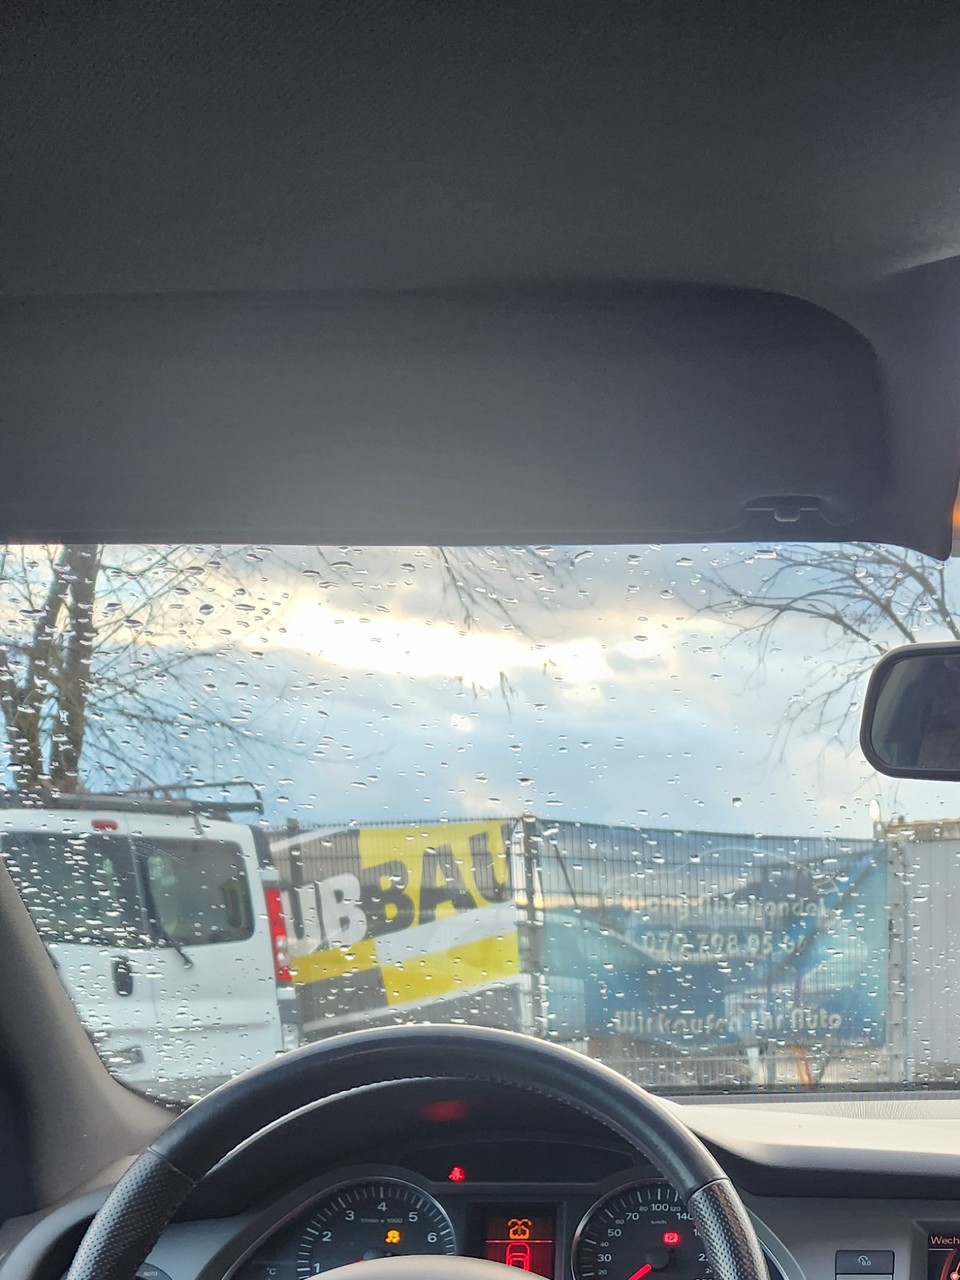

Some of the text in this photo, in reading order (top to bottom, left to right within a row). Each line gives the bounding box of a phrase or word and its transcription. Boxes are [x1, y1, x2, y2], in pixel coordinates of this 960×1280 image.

[614, 1010, 652, 1034] Wir
[791, 1007, 842, 1030] Auto
[377, 1201, 388, 1212] 4
[650, 1203, 669, 1212] 100
[345, 1210, 355, 1221] 3
[408, 1211, 418, 1222] 5
[625, 1212, 640, 1221] 70
[676, 1212, 694, 1221] 140
[322, 1231, 332, 1242] 2
[427, 1232, 437, 1243] 6
[607, 1228, 622, 1237] 50
[597, 1253, 612, 1262] 30
